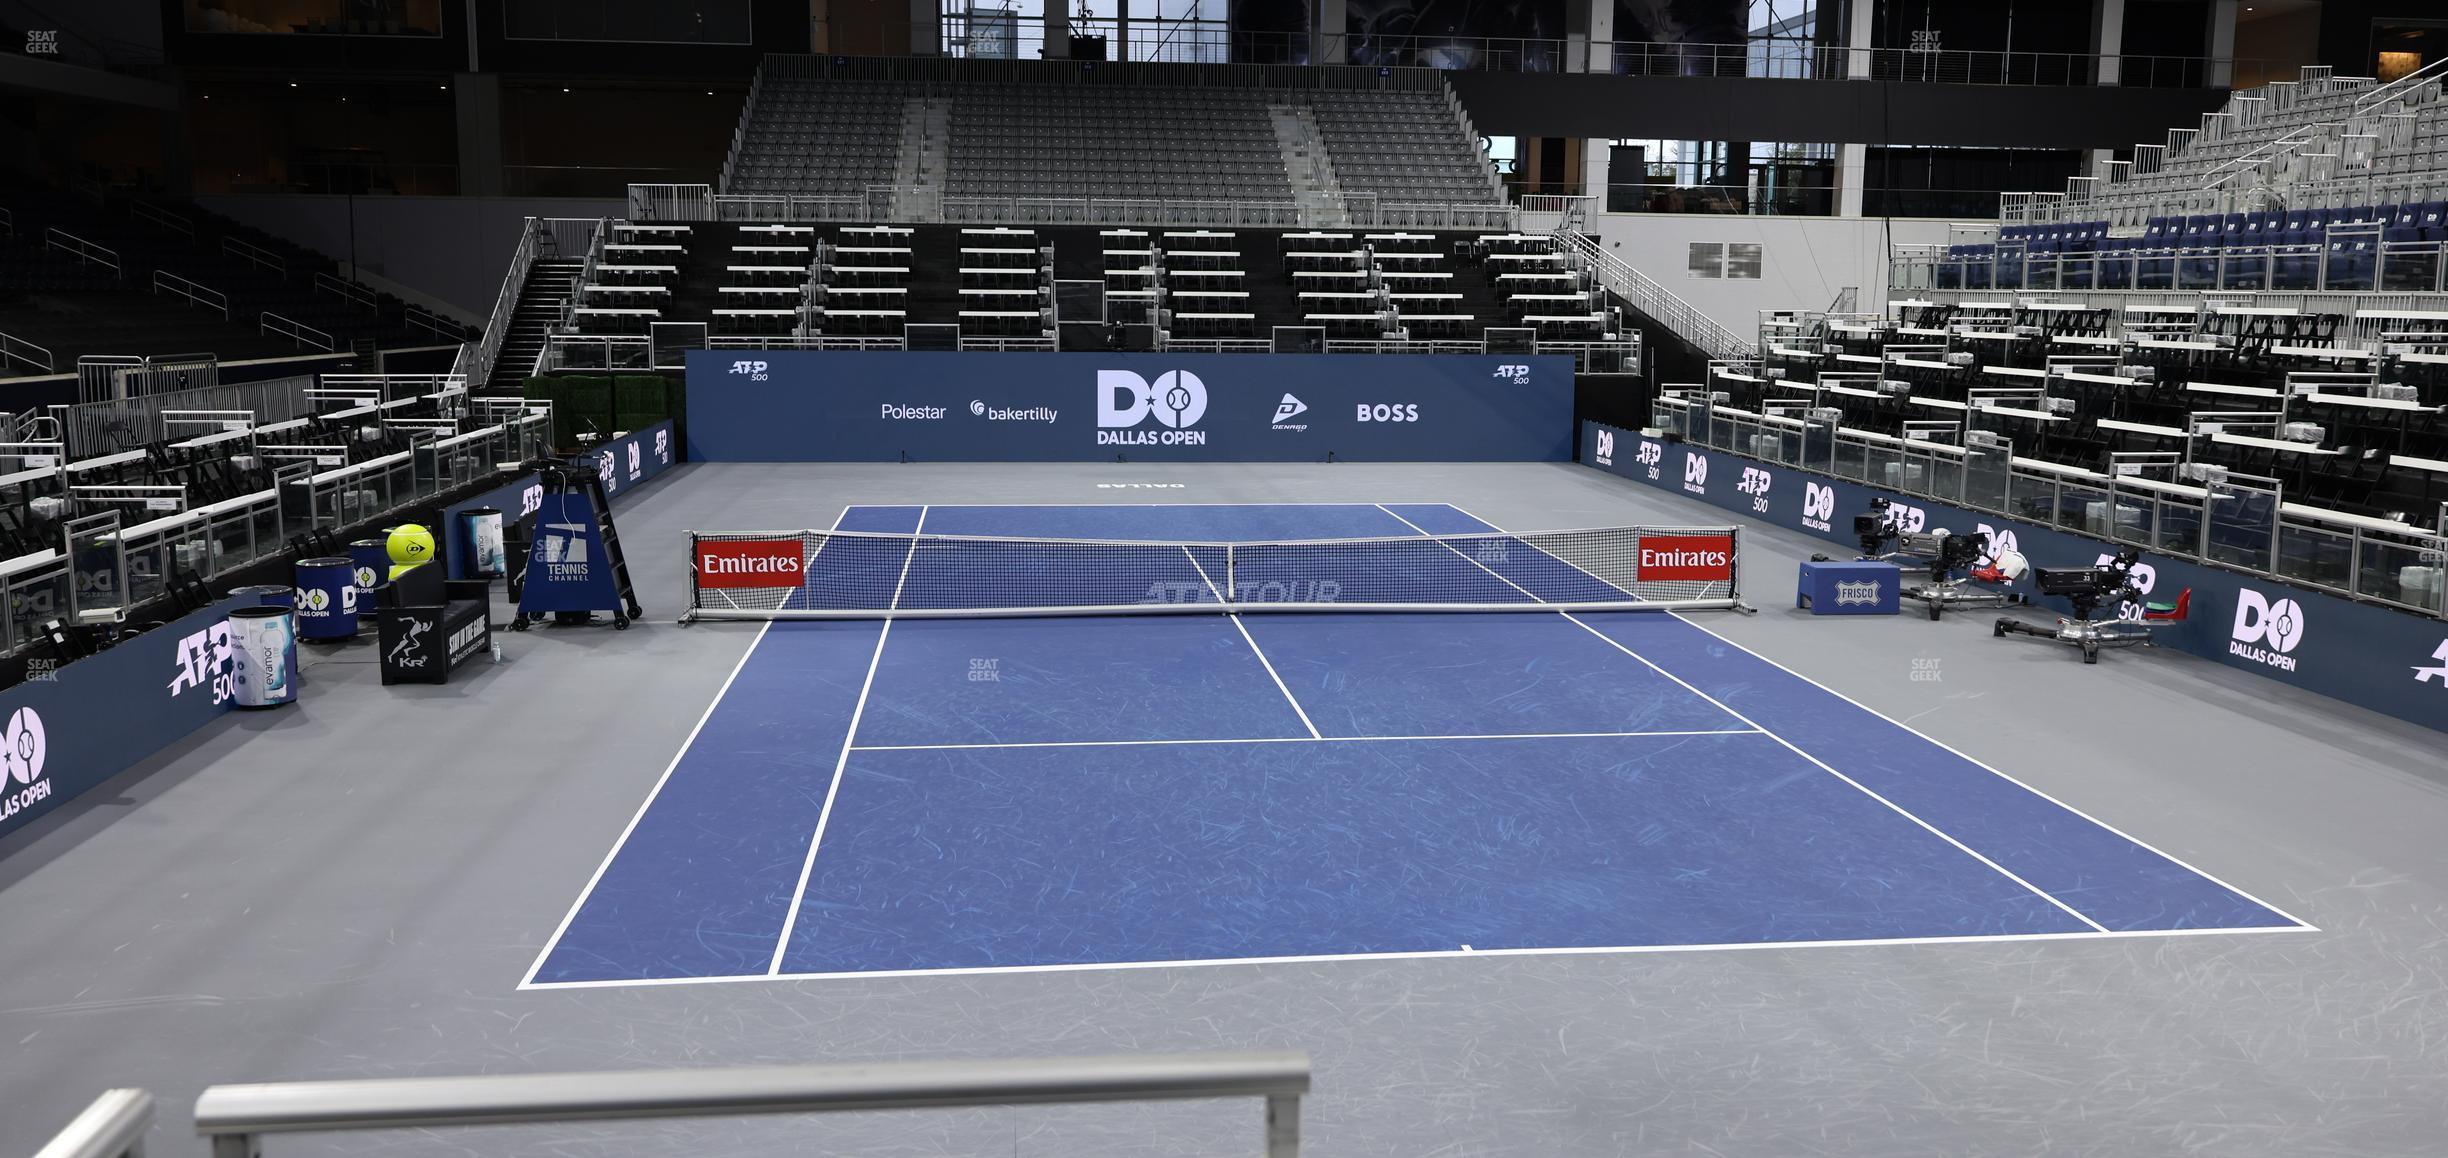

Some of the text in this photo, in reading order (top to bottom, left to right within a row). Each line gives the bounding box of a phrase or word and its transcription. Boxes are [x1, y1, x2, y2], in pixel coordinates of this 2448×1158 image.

[728, 360, 768, 374] ATP
[1492, 365, 1530, 378] ATP
[751, 373, 768, 381] 500
[1513, 377, 1529, 385] 500
[1097, 369, 1208, 429] DO
[881, 403, 946, 420] Polestar
[988, 407, 1058, 424] bakertilly
[1357, 403, 1419, 422] BOSS
[1097, 431, 1206, 446] DALLAS OPEN
[1597, 429, 1614, 458] DO
[1635, 440, 1662, 466] ATP
[1648, 467, 1660, 480] 500
[1685, 452, 1708, 485] DO
[1684, 482, 1705, 495] DALLAS OPEN
[1736, 466, 1772, 496] ATP
[1753, 496, 1769, 513] 500
[1803, 482, 1835, 521] DO
[1802, 516, 1831, 533] DALLAS OPEN
[703, 553, 799, 574] Emirates
[1641, 548, 1726, 567] Emirates
[547, 563, 588, 575] TENNIS
[1234, 580, 1341, 603] TOUR
[1842, 587, 1874, 599] FRISCO
[2231, 587, 2305, 654] DO
[167, 620, 232, 697] ATP
[265, 645, 274, 686] evamor
[2229, 641, 2297, 673] DALLAS OPEN
[0, 706, 47, 796] O
[0, 778, 51, 822] LAS OPEN
